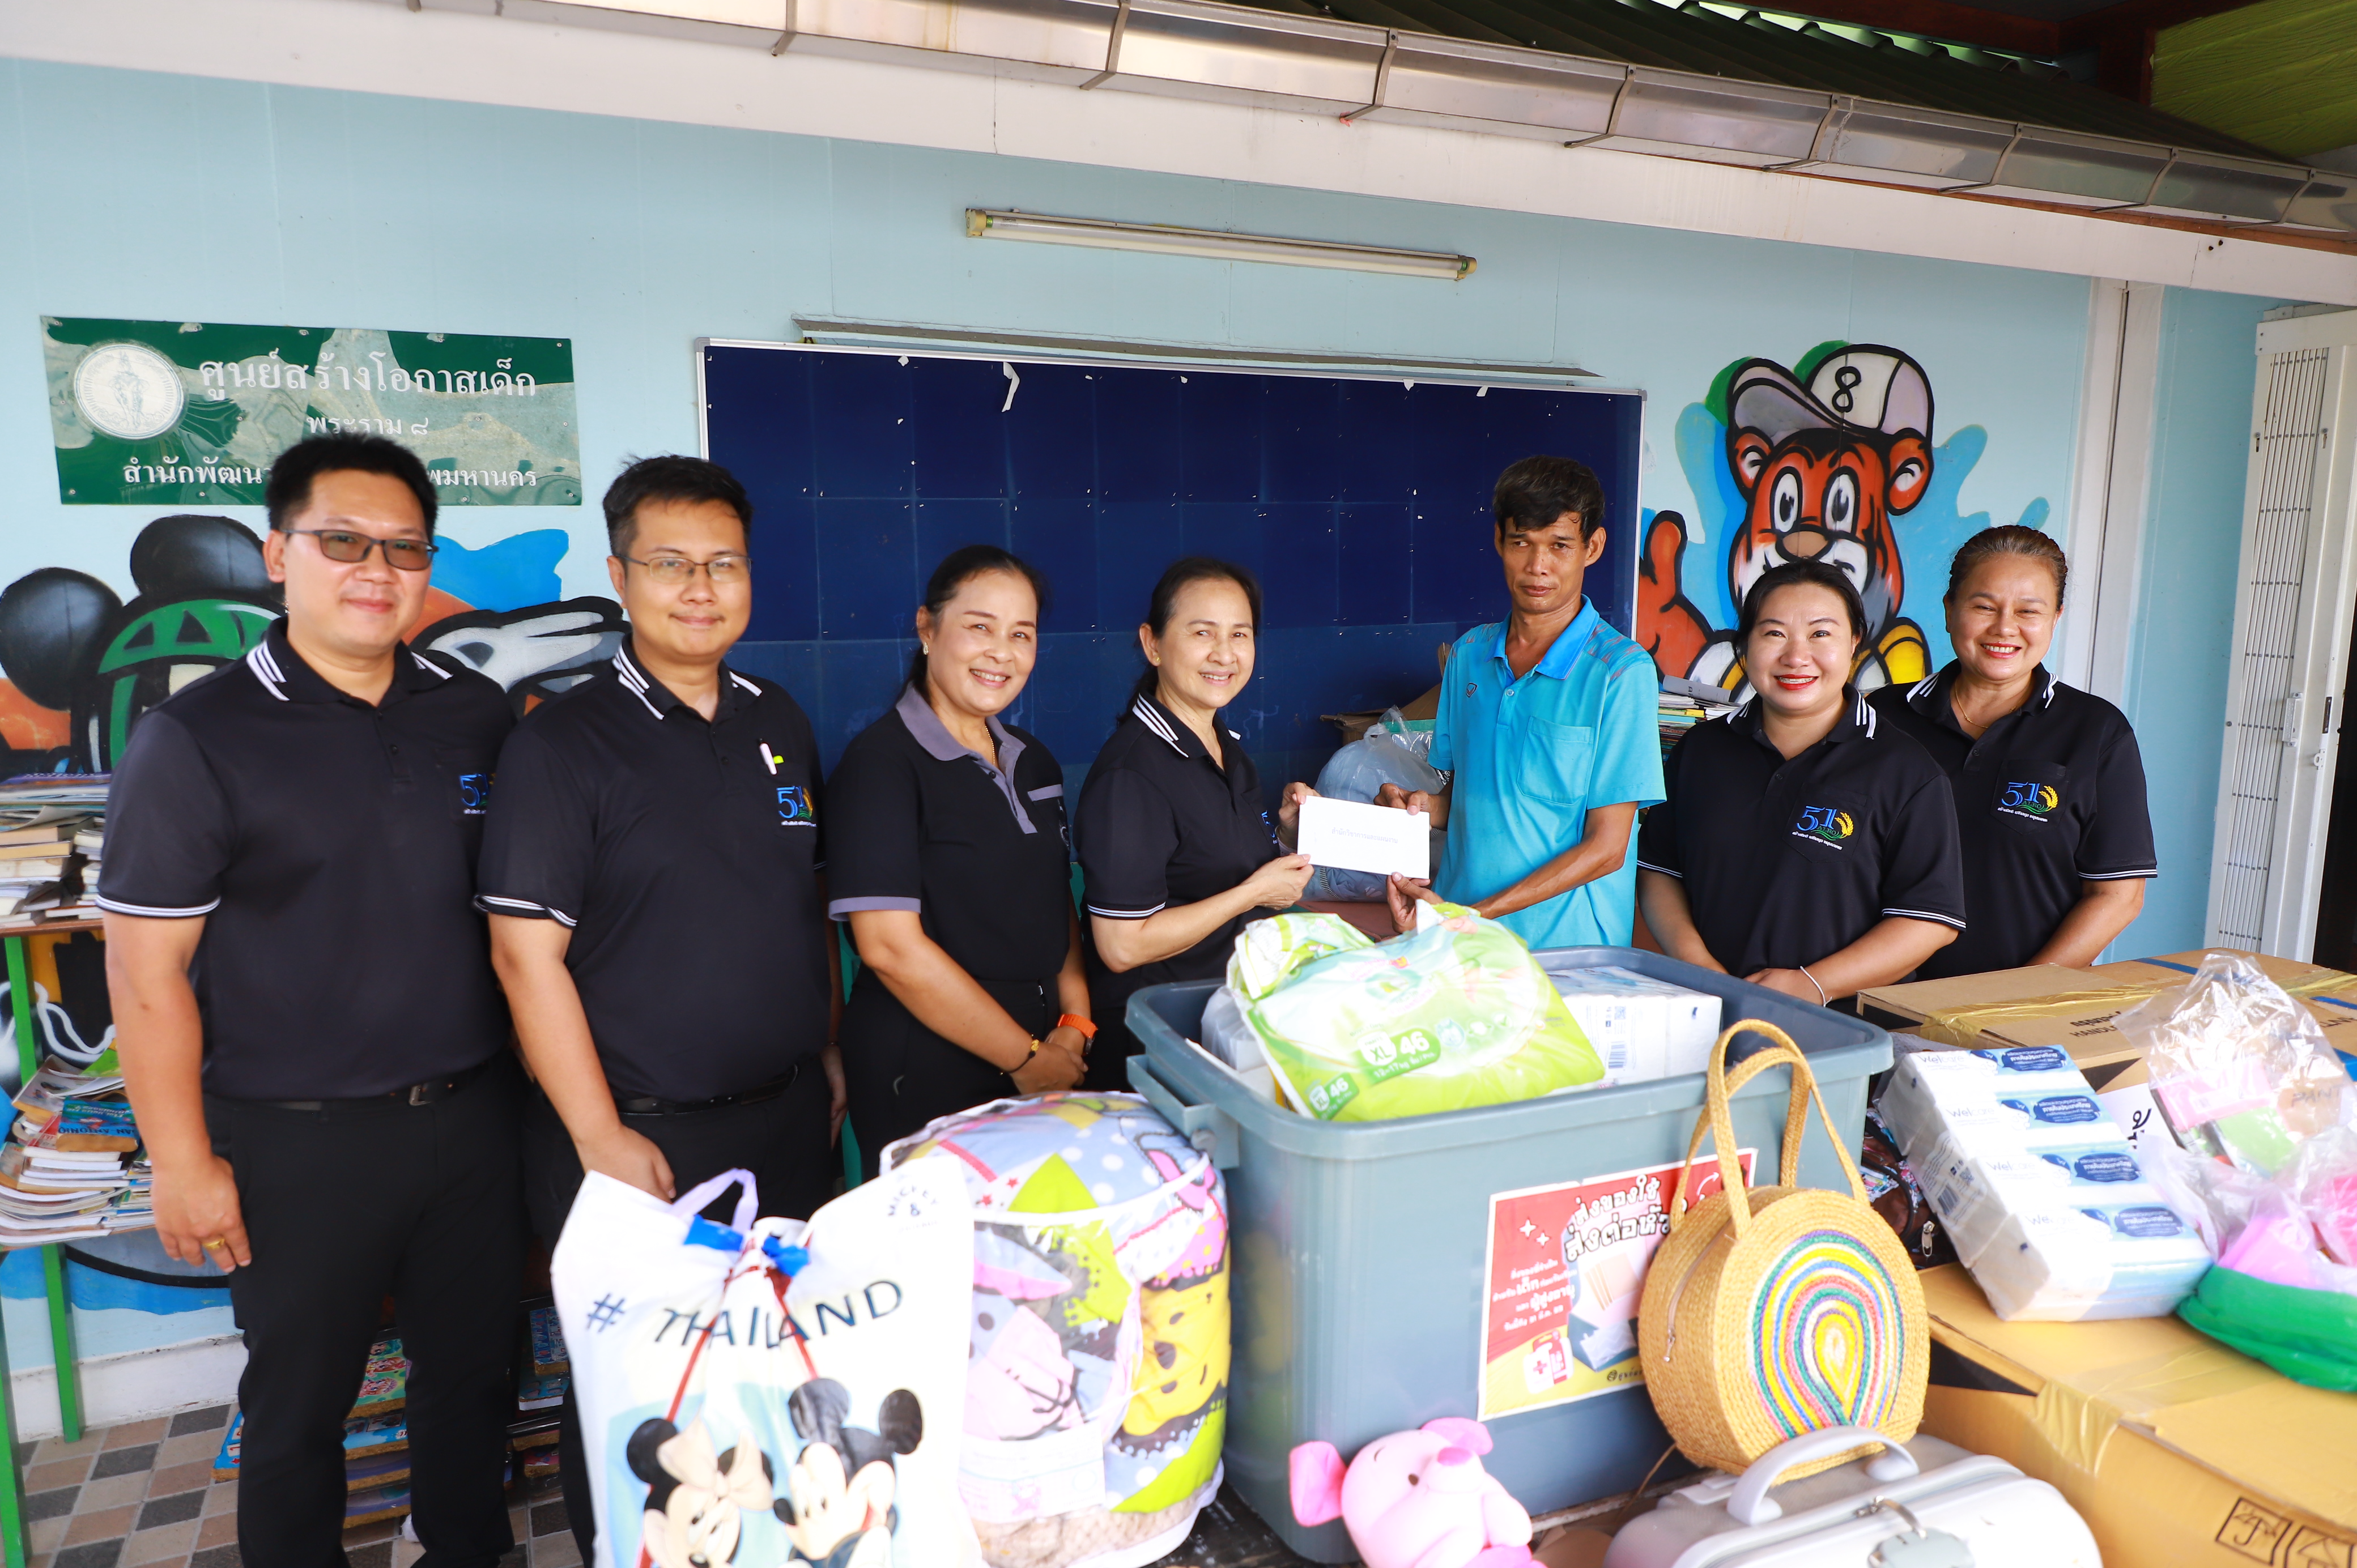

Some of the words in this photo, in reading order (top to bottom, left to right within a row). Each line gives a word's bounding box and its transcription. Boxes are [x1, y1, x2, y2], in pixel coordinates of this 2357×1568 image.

[200, 348, 536, 402] ศูนย์สร้างโอกาสเด็ก
[1832, 365, 1862, 412] 8
[307, 416, 402, 434] พระราม
[411, 417, 429, 435] ๘
[429, 468, 537, 487] พมหานคร
[776, 786, 807, 819] 51
[2001, 782, 2040, 807] 51
[2023, 800, 2042, 810] ALRO
[1796, 806, 1837, 831] 51
[1331, 827, 1398, 843] สำนักวิชาการและแผนงาน
[1817, 825, 1837, 836] ALRO
[1369, 1045, 1392, 1062] XL
[1400, 1031, 1430, 1055] 46
[1917, 1055, 1965, 1063] Welcare
[1330, 1077, 1349, 1097] 46
[1946, 1107, 1995, 1117] Welcare
[1986, 1161, 2036, 1171] Welcare
[1574, 1174, 1661, 1226] ส่งของใช้
[1516, 1276, 1539, 1295] เด็ก
[1530, 1285, 1576, 1311] ผู้สูงอายุ
[655, 1280, 903, 1349] THAILAND
